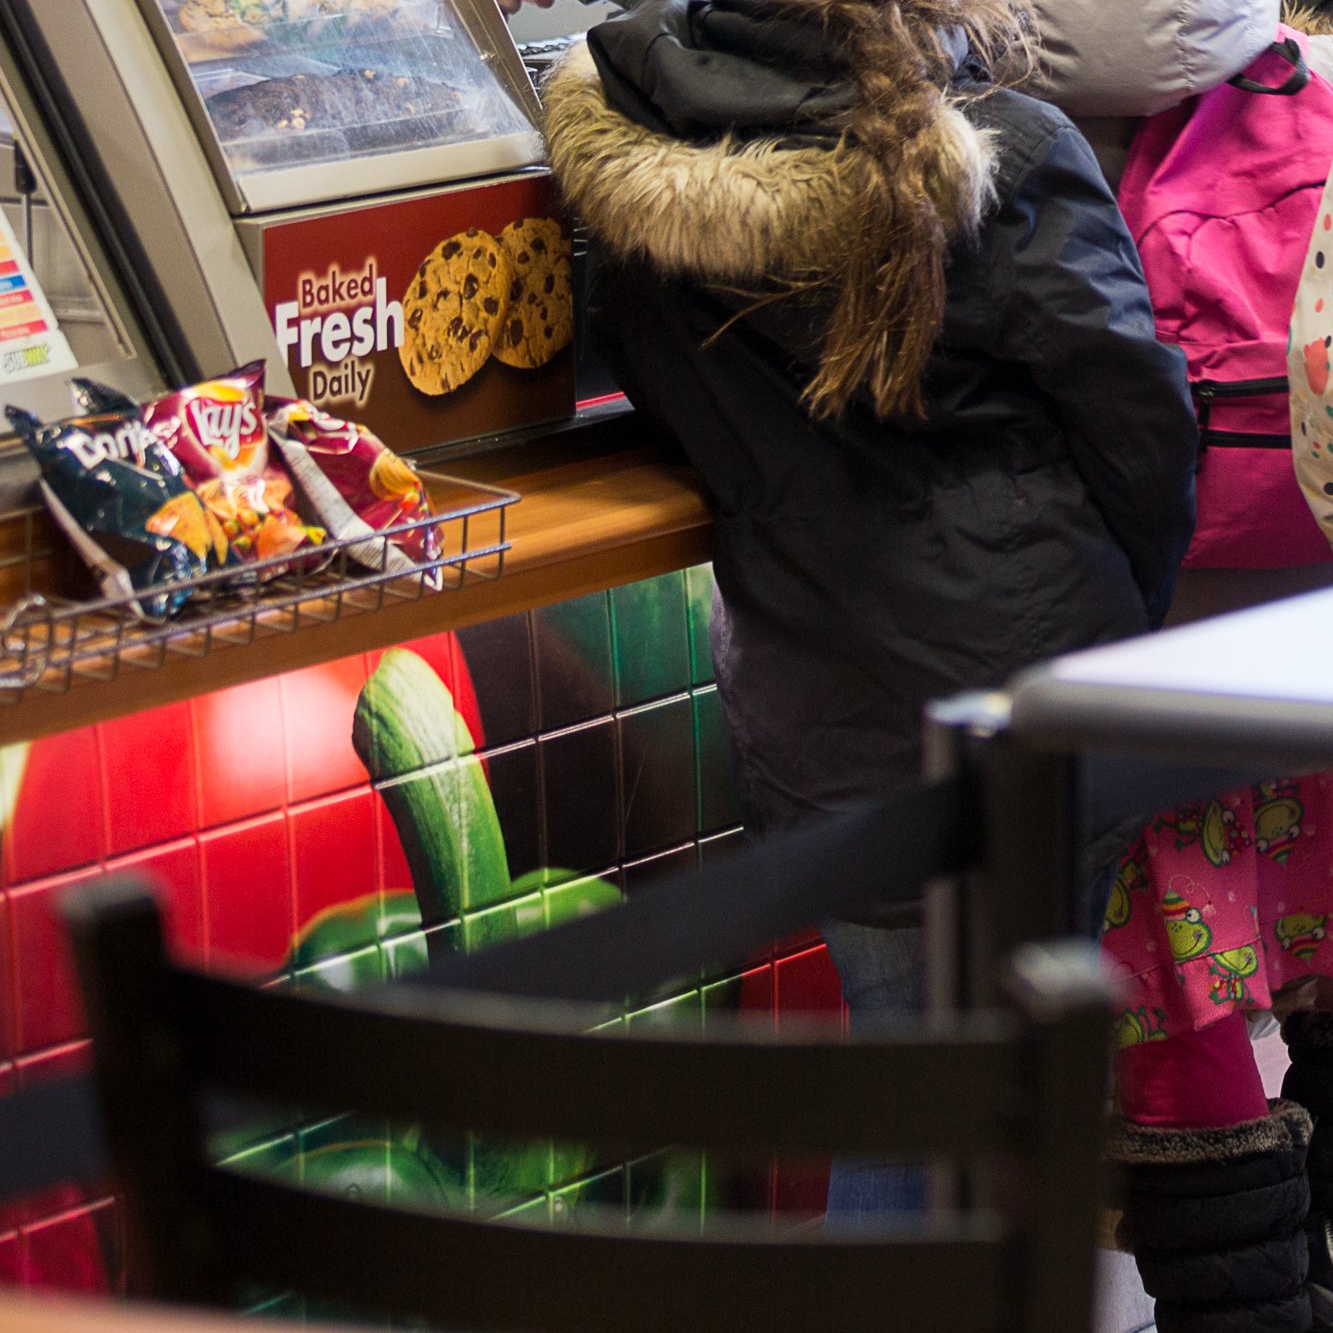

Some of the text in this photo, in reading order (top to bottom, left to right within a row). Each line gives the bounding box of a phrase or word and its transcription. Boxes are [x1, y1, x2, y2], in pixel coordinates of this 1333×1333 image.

[302, 263, 373, 309] Baked
[276, 277, 405, 368] Fresh
[312, 360, 371, 401] Daily
